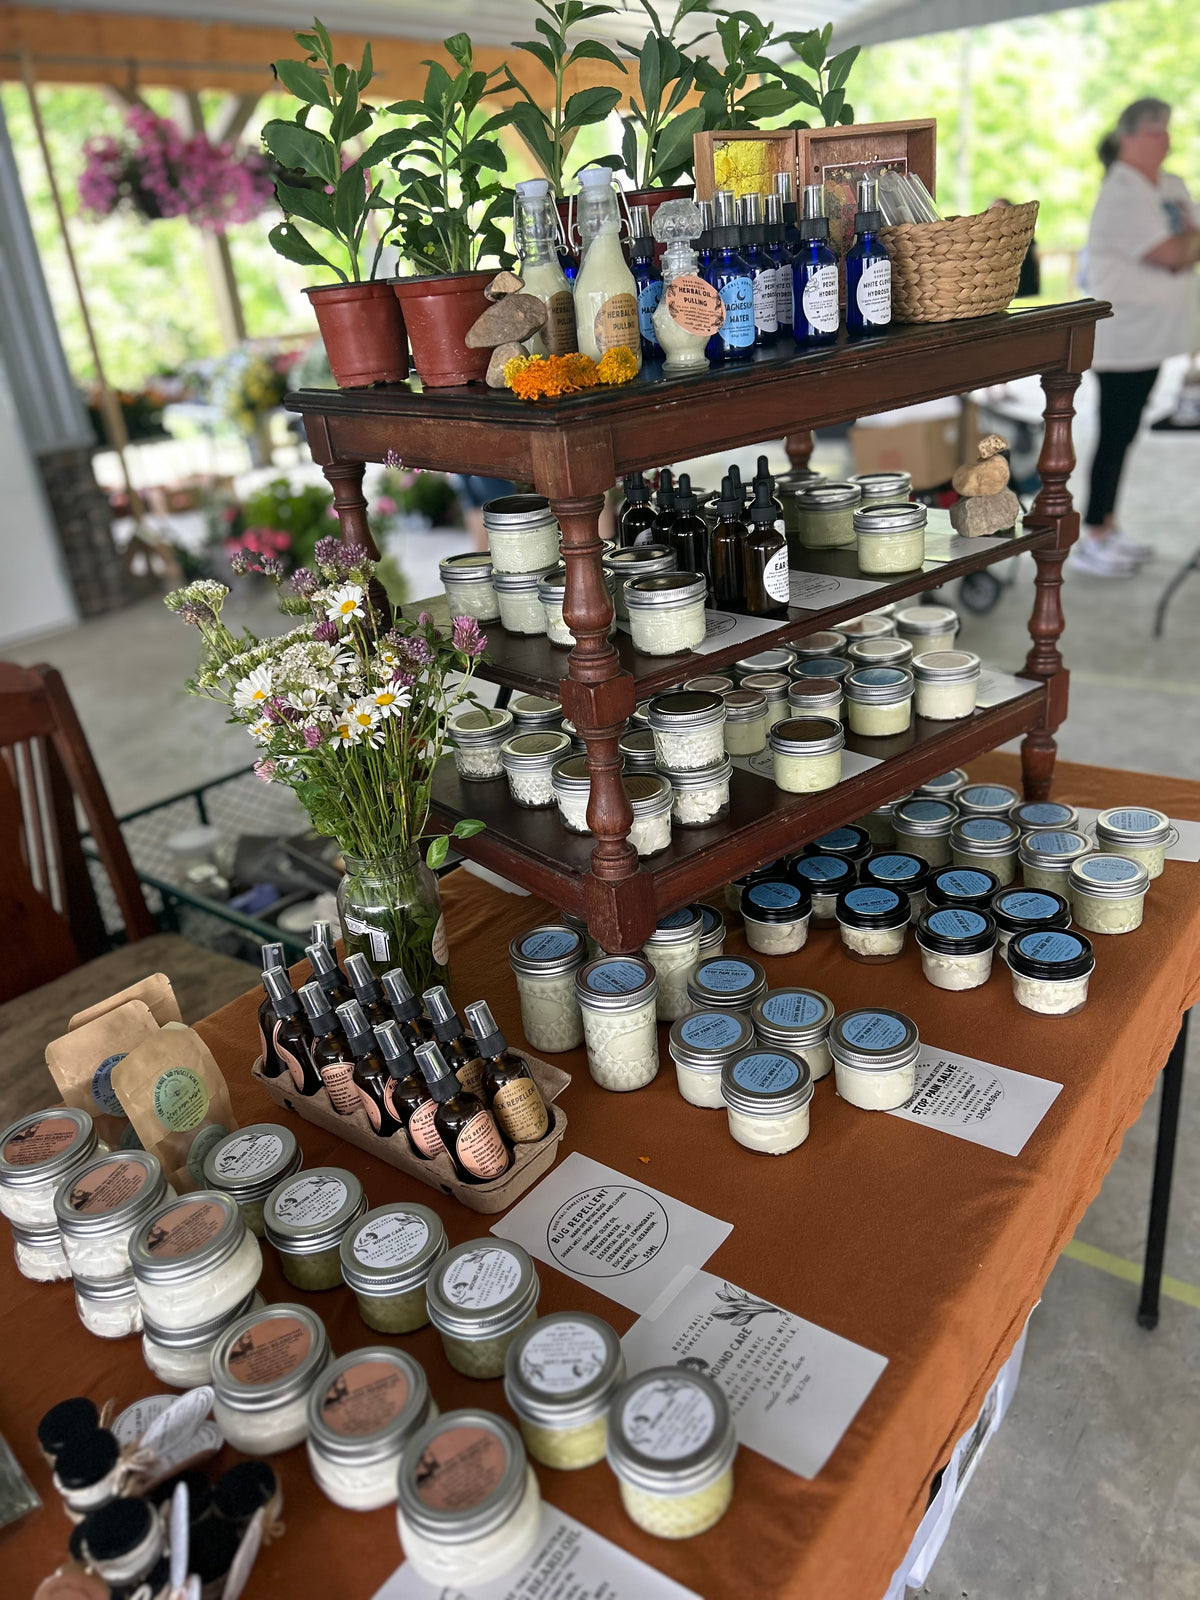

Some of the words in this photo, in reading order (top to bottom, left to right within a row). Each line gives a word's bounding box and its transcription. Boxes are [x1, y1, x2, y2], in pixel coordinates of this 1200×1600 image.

[678, 287, 702, 296] HERBAL
[684, 297, 707, 306] PULLING
[608, 310, 631, 318] HERBAL
[613, 321, 635, 329] PULLING
[775, 562, 786, 570] EAR
[711, 1019, 726, 1027] SALVE
[911, 1098, 928, 1114] STOP
[925, 1083, 941, 1098] PAIN
[936, 1064, 957, 1083] SALVE
[460, 1134, 471, 1142] BUG
[309, 1187, 321, 1196] CARE
[551, 1227, 569, 1243] BUG
[567, 1189, 607, 1227] REPELLENT
[372, 1233, 390, 1244] WOUND
[391, 1226, 404, 1235] CARE
[581, 1233, 600, 1251] ORGANIC
[598, 1222, 611, 1234] OLIVE
[588, 1236, 608, 1255] FILTERED
[596, 1238, 618, 1259] ESSENTIAL
[642, 1245, 658, 1258] 55ML
[475, 1262, 484, 1274] CARE
[671, 1315, 709, 1350] ROSE-HALL
[674, 1316, 712, 1354] HOMESTEAD
[730, 1327, 751, 1350] CARE
[724, 1372, 737, 1386] ALL
[736, 1336, 763, 1368] ORGANIC
[740, 1370, 752, 1382] OIL
[751, 1336, 777, 1367] INFUSED
[781, 1371, 792, 1388] with
[527, 1550, 563, 1594] BEARD
[560, 1530, 580, 1550] OIL
